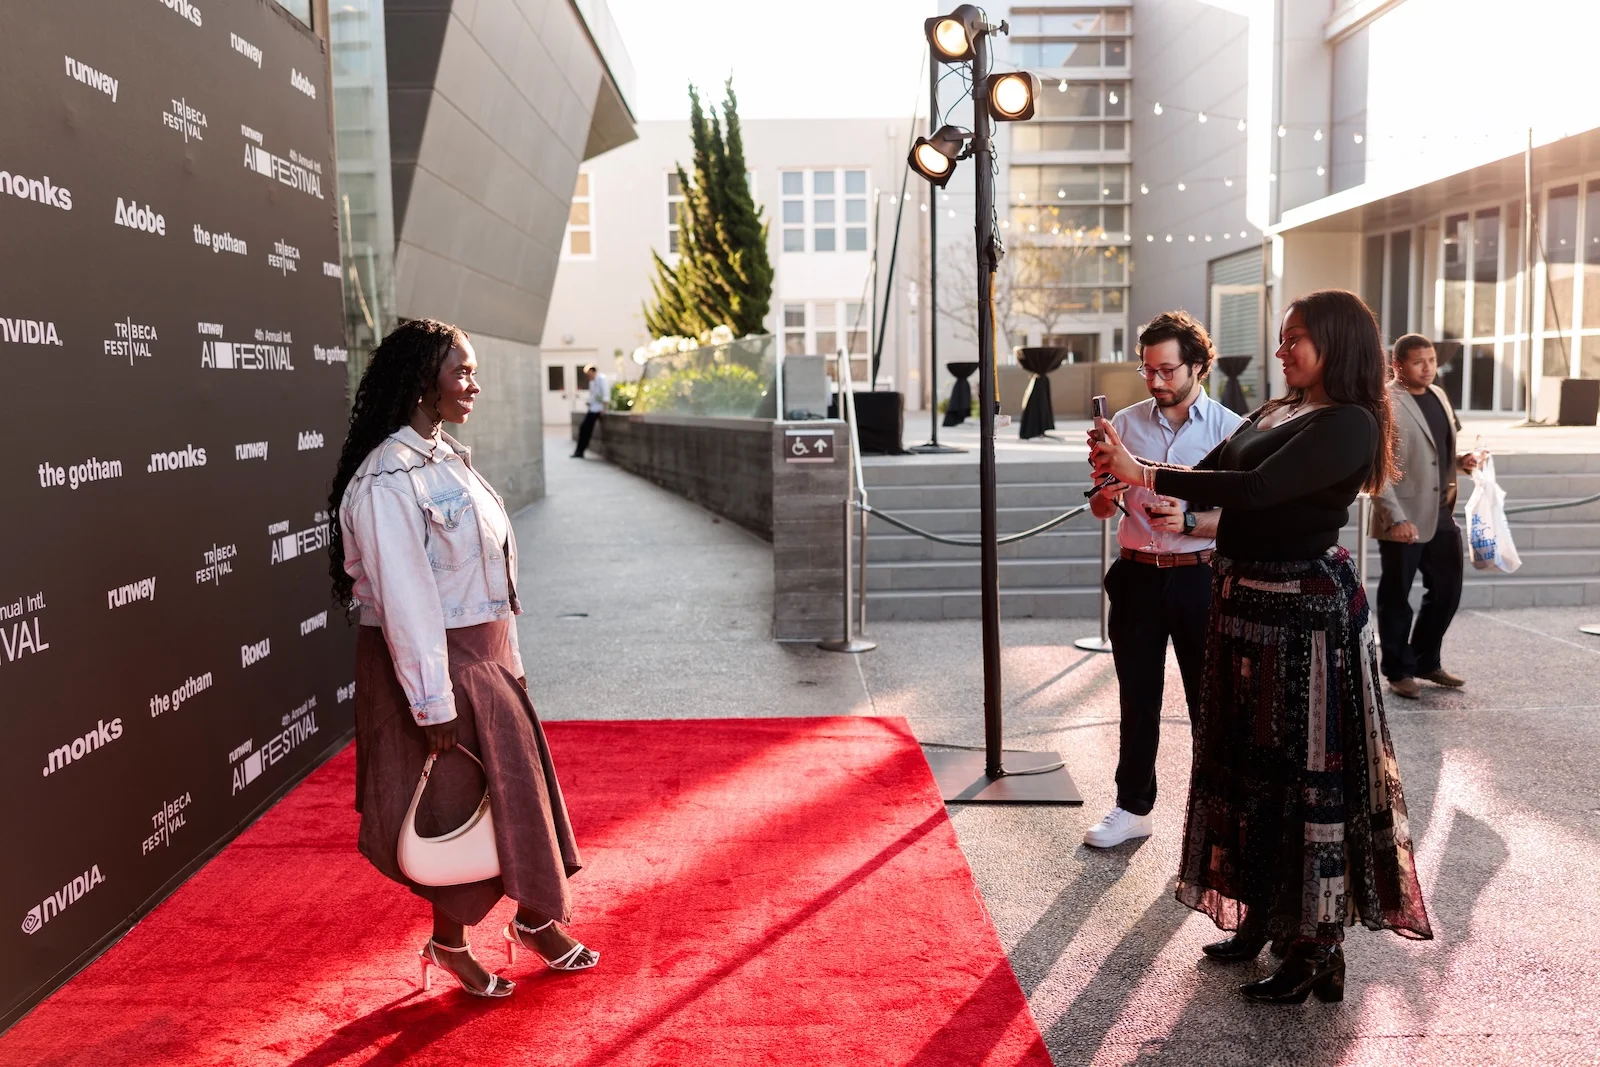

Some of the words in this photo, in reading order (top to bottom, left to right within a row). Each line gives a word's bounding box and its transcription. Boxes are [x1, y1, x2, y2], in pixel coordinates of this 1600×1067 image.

[230, 32, 263, 69] runway
[65, 54, 119, 103] runway
[291, 68, 316, 100] Adobe
[163, 111, 203, 141] FESTIVAL
[172, 98, 208, 128] TRIBECA
[241, 124, 263, 147] runway
[271, 154, 324, 200] FESTIVAL
[115, 197, 166, 236] Adobe
[193, 224, 211, 247] the
[212, 232, 248, 255] gotham
[274, 241, 300, 260] TRIBECA
[268, 254, 297, 272] FESTIVAL
[115, 321, 158, 341] TRIBECA
[198, 322, 223, 338] runway
[254, 328, 264, 341] 4th
[265, 330, 282, 343] Annual
[104, 340, 152, 357] FESTIVAL
[233, 343, 294, 370] FESTIVAL
[314, 344, 326, 360] the
[235, 441, 268, 461] runway
[297, 430, 324, 451] Adobe
[38, 462, 65, 488] the
[69, 456, 123, 490] gotham
[268, 520, 290, 535] runway
[296, 523, 333, 556] FESTI
[204, 543, 238, 565] TRIBECA
[196, 560, 233, 584] FESTIVAL
[108, 576, 156, 610] runway
[300, 610, 328, 636] runway
[241, 638, 270, 668] Roku
[150, 692, 170, 717] the
[172, 671, 213, 711] gotham
[336, 686, 348, 703] the
[291, 700, 308, 721] Annual
[229, 738, 252, 764] runway
[261, 711, 319, 771] FESTIVAL
[152, 791, 192, 829] TRIBECA
[142, 816, 186, 856] FESTIVAL
